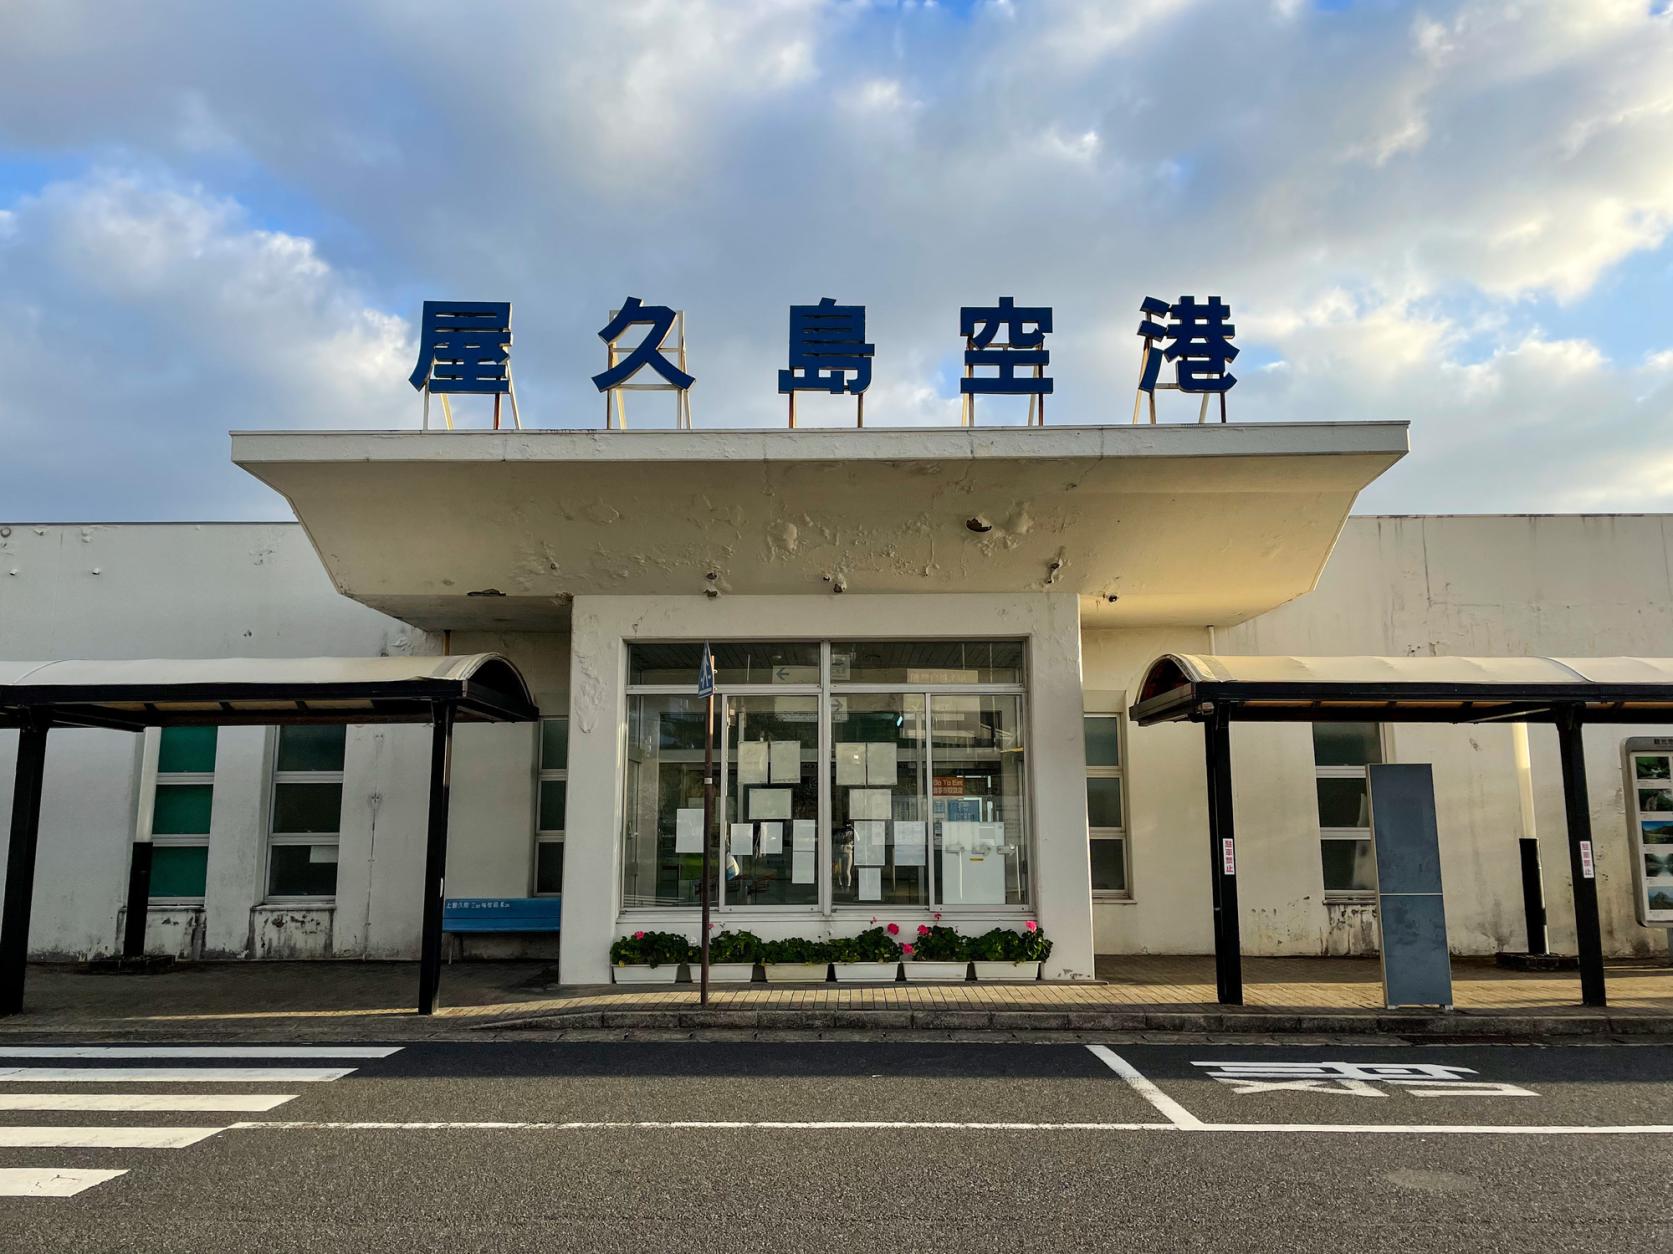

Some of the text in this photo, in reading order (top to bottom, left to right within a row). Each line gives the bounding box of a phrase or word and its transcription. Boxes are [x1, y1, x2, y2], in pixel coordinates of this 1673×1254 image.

[409, 296, 1240, 394] 屋久島空港
